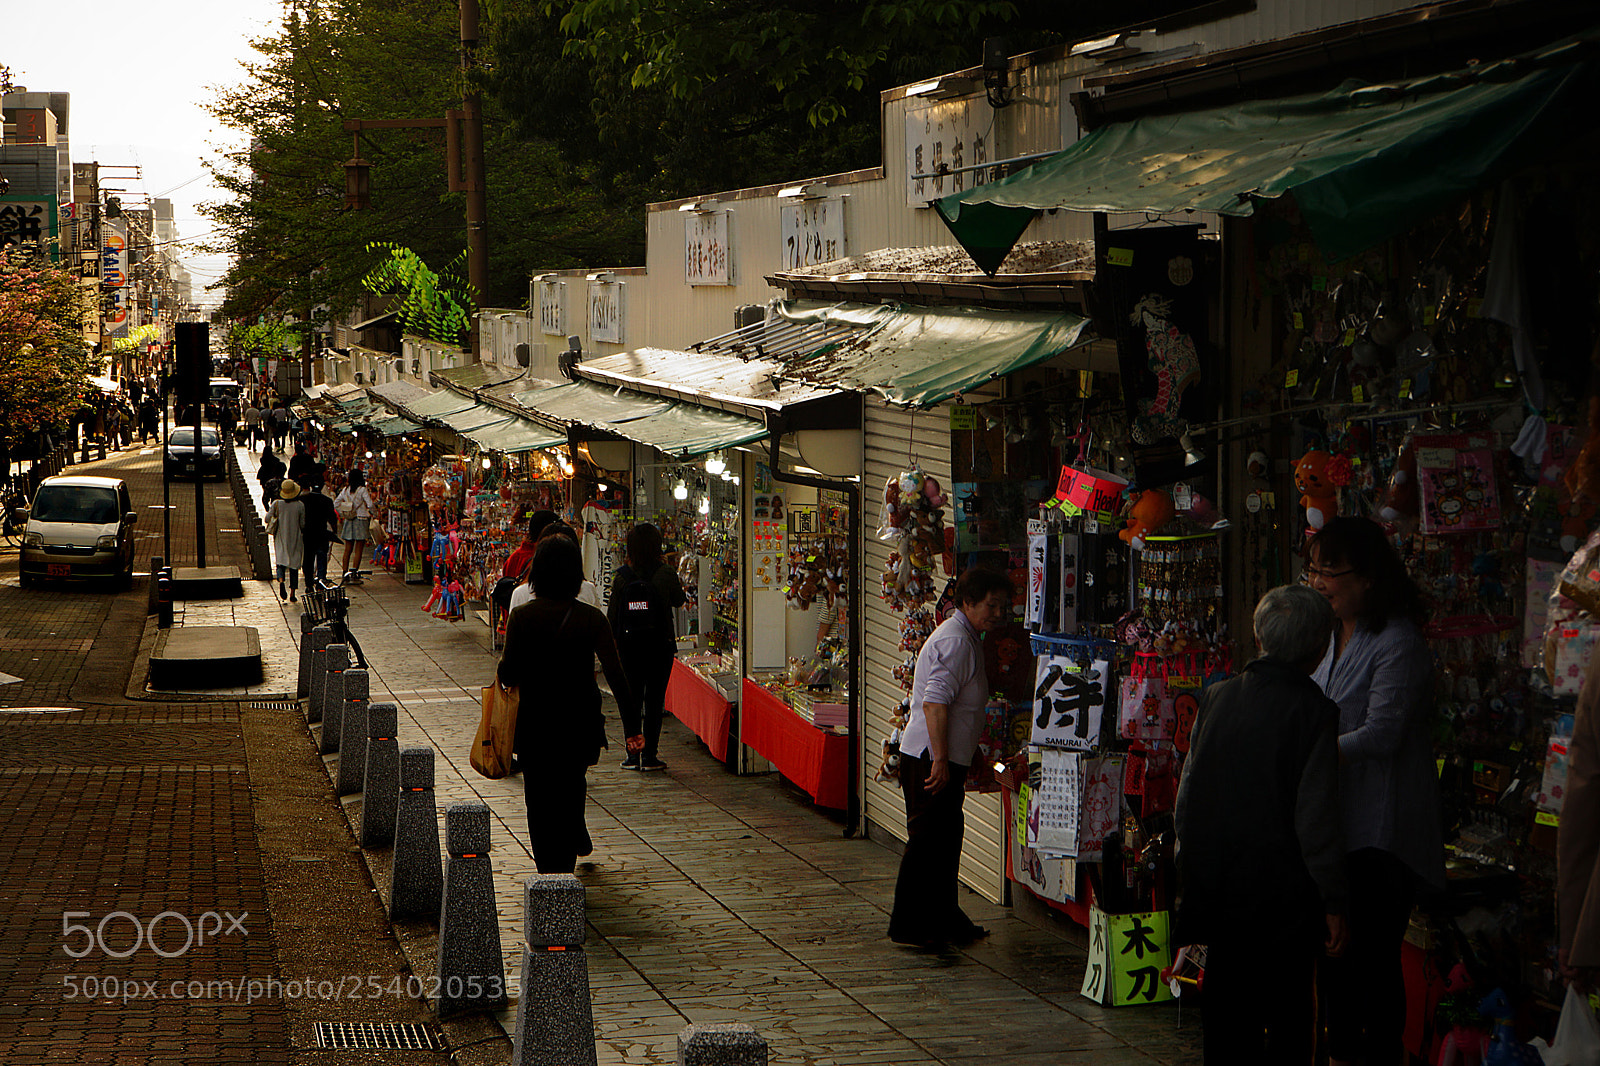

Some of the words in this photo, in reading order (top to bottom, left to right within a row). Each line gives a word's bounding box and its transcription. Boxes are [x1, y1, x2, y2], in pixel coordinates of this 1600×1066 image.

[628, 601, 649, 611] MARVEL
[1036, 660, 1104, 739] 侍
[1045, 737, 1082, 747] SAMURAI
[1087, 913, 1104, 998] 木刀
[1121, 917, 1161, 1002] 木刀
